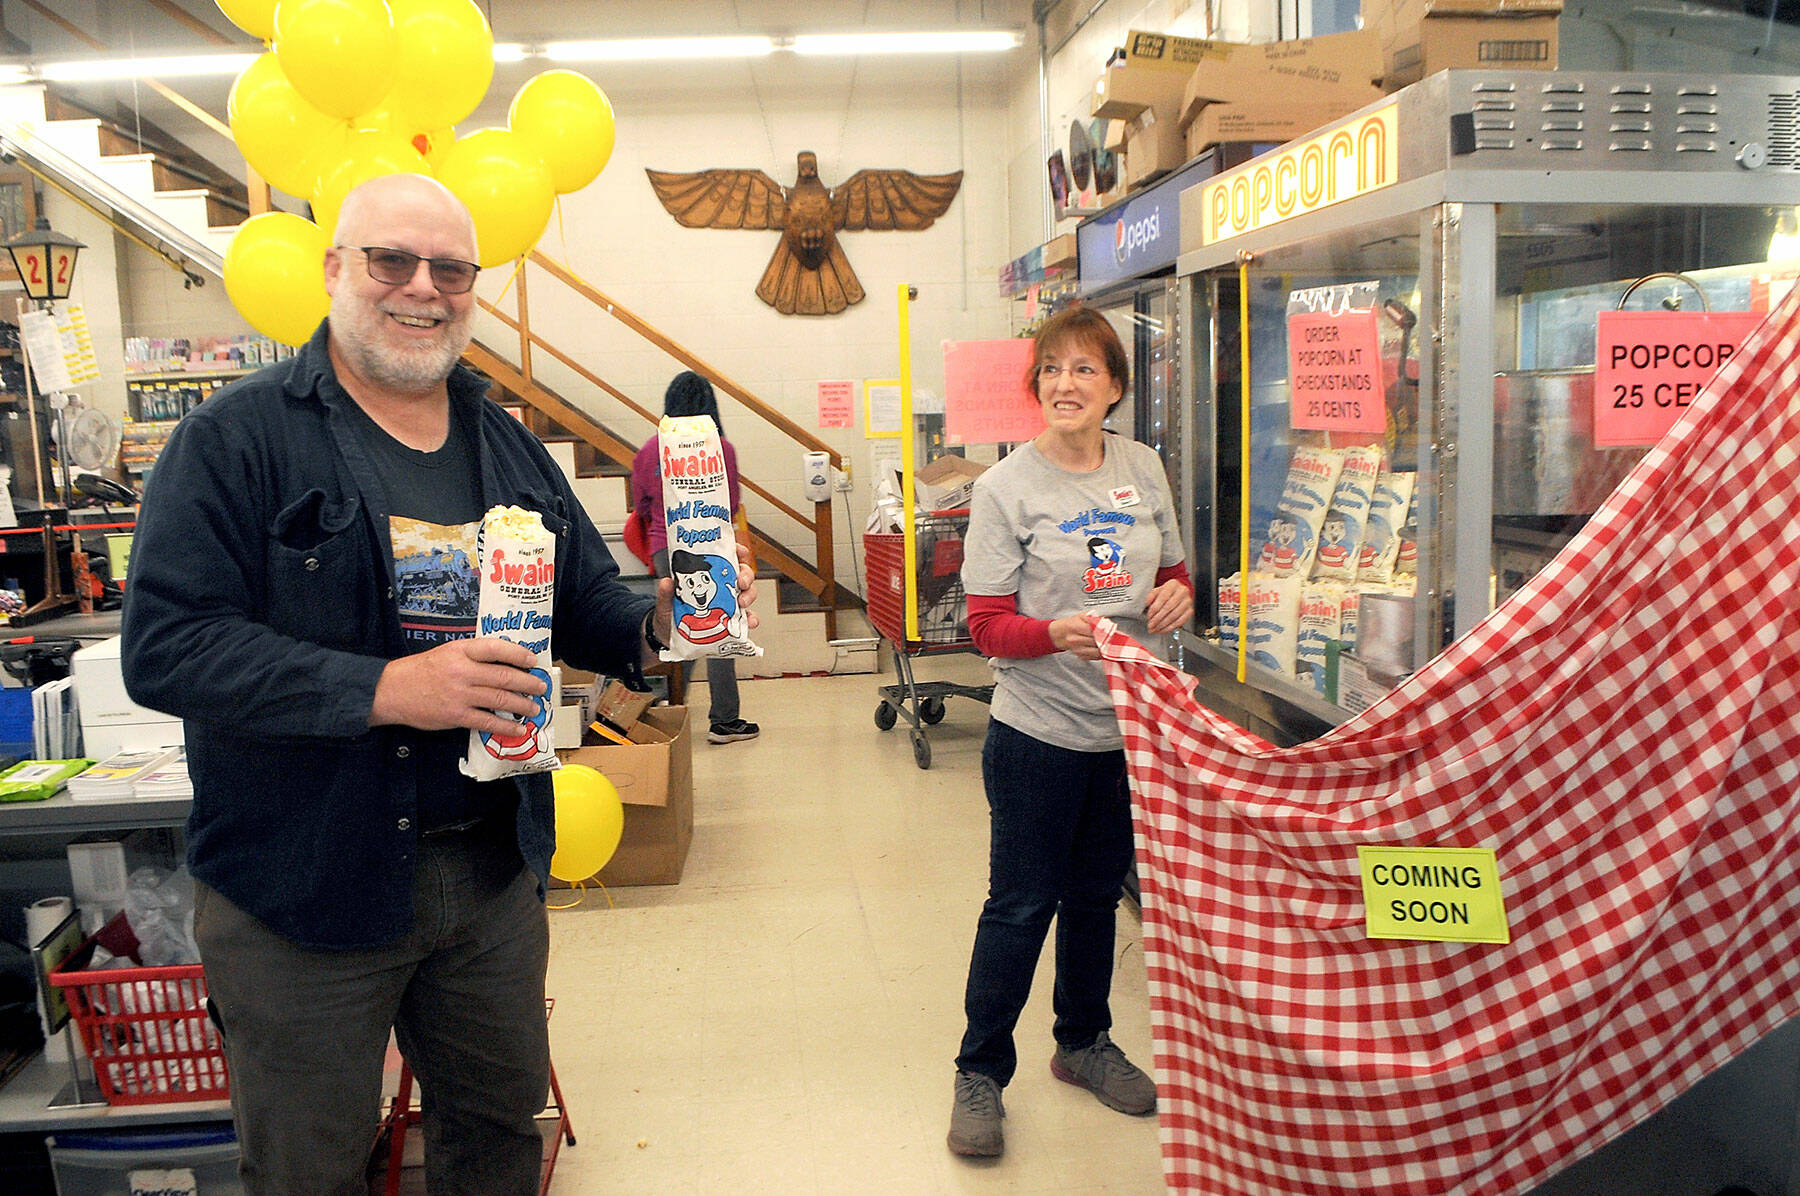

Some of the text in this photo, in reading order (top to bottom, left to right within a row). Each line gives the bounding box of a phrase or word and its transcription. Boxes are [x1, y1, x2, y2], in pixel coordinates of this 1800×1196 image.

[1127, 205, 1160, 258] pepsi
[27, 255, 42, 284] 2
[57, 255, 69, 284] 2
[1304, 326, 1341, 343] ORDER
[1298, 348, 1363, 367] POPCORN AT
[1611, 344, 1735, 369] POPCOR
[1296, 374, 1372, 391] CHECKSTANDS
[1613, 384, 1645, 409] 25
[1322, 400, 1361, 419] CENTS
[676, 525, 722, 549] Popcorn
[490, 548, 555, 586] Swain
[500, 585, 541, 595] GENERAL
[1082, 567, 1133, 593] Swain's
[407, 629, 476, 641] IER NAT
[480, 610, 554, 636] World Fam
[1372, 864, 1482, 889] COMING
[1390, 899, 1469, 925] SOON
